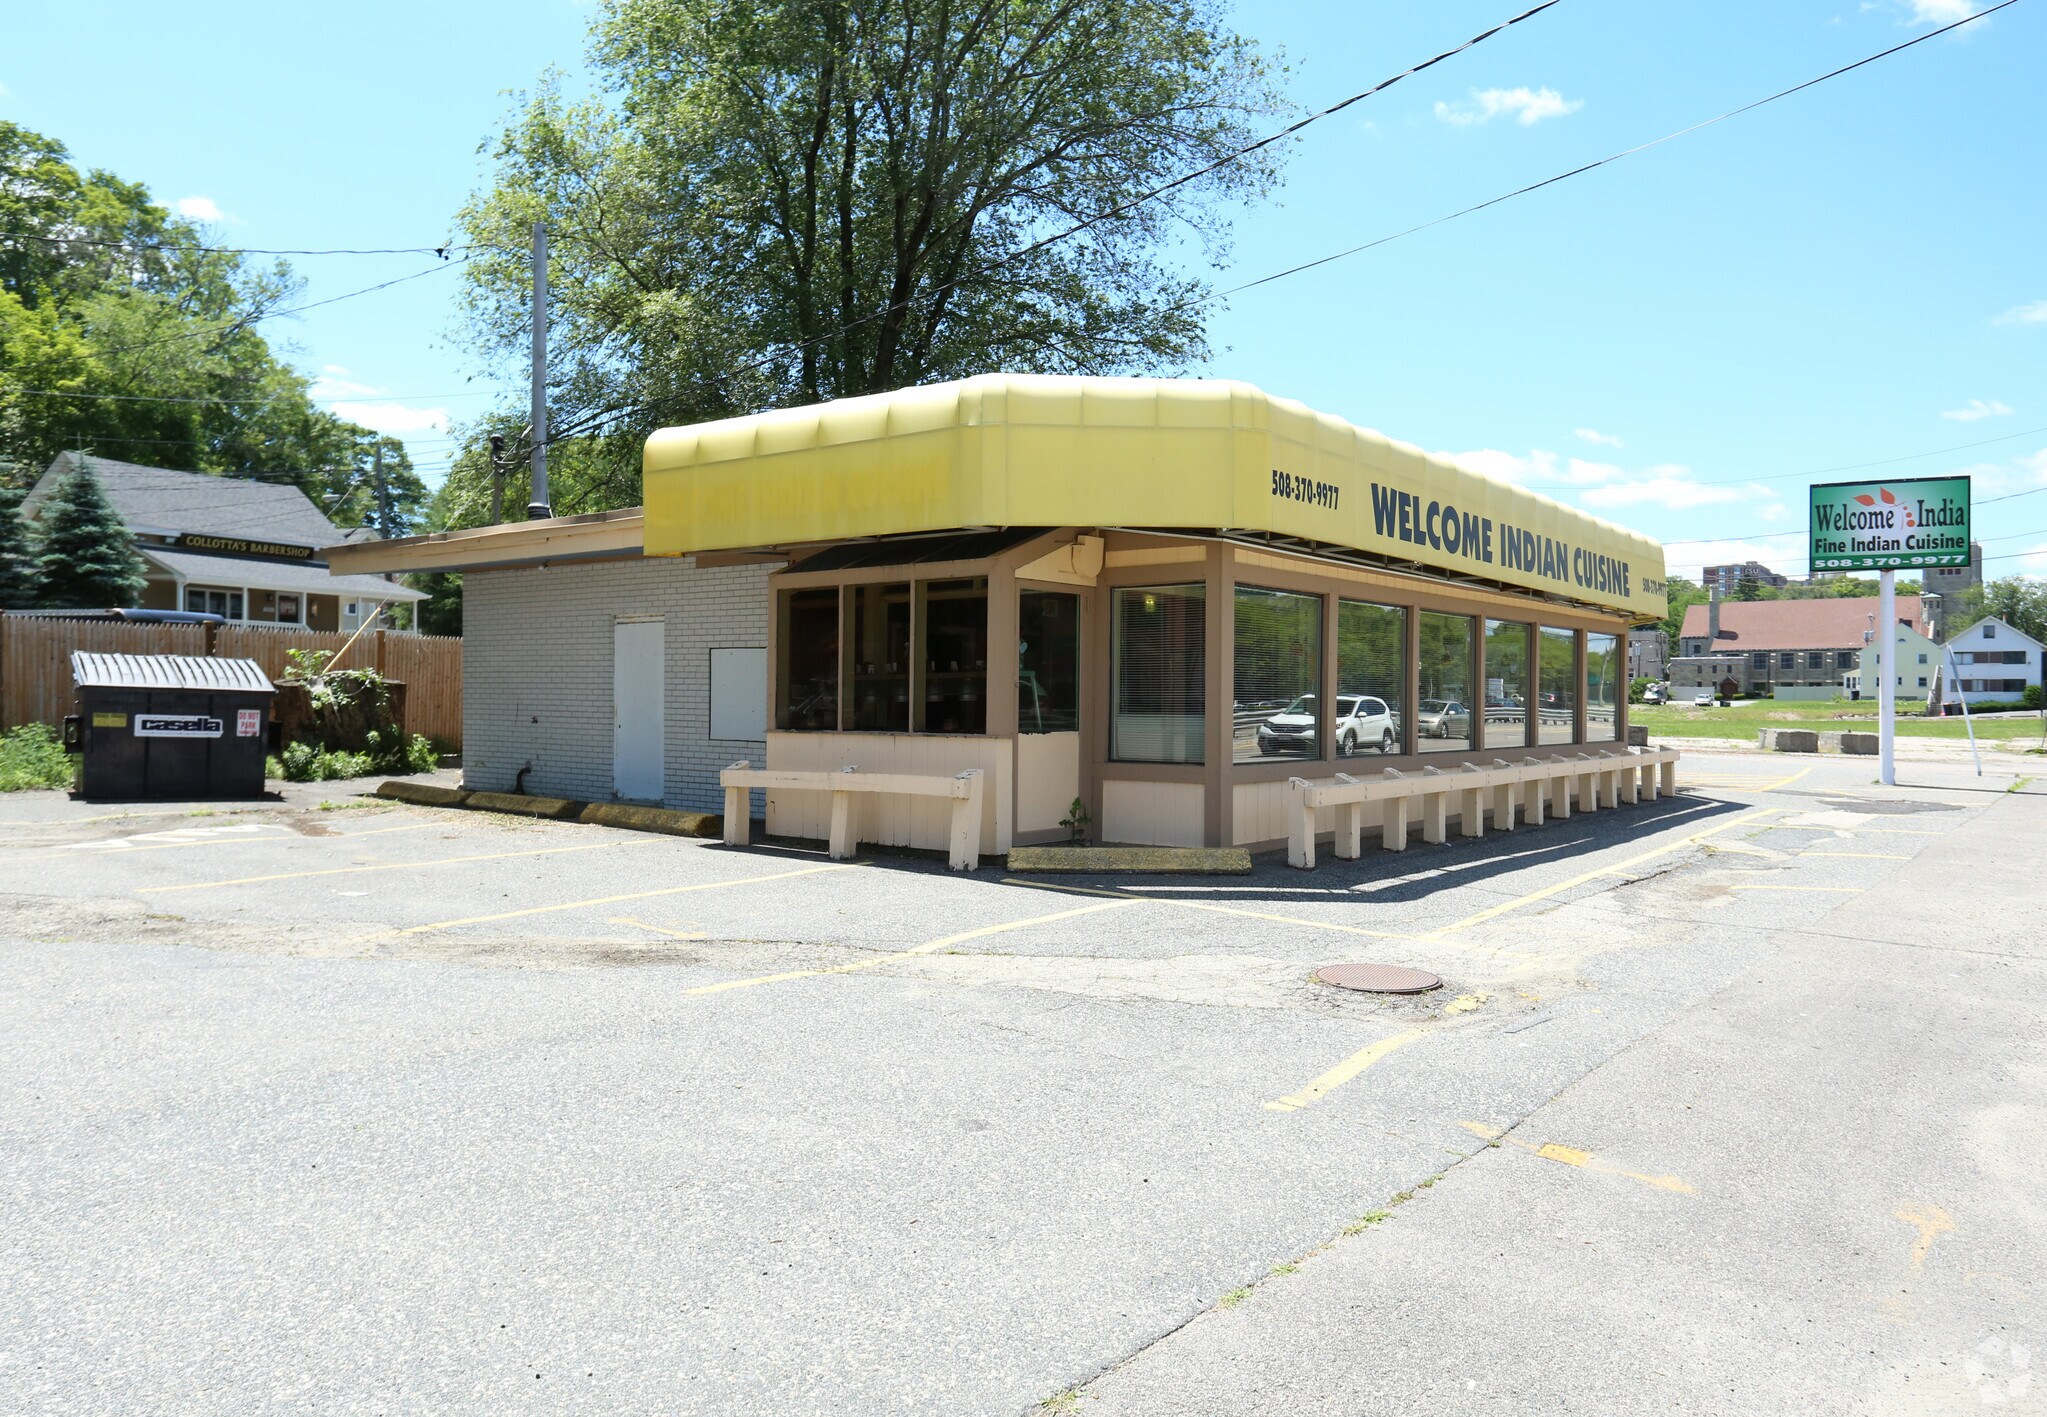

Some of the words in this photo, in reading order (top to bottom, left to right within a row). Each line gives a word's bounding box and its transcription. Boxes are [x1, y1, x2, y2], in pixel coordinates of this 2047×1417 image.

[1272, 469, 1339, 510] 508-370-9977
[1815, 503, 1894, 532] Welcome
[1917, 498, 1965, 527] India
[186, 536, 247, 551] COLLOTTA'S
[250, 543, 310, 558] BARBERSHOP
[1371, 483, 1493, 564] WELCOME
[1500, 523, 1568, 582] INDIAN
[1573, 547, 1630, 597] CUISINE
[1815, 538, 1846, 553] Fine
[1851, 536, 1900, 552] Indian
[1906, 533, 1965, 550] Cuisine
[1815, 555, 1965, 568] 508-370-9977
[141, 718, 220, 731] casella
[239, 712, 247, 720] DO
[248, 712, 259, 720] NOT
[240, 721, 256, 729] PARK
